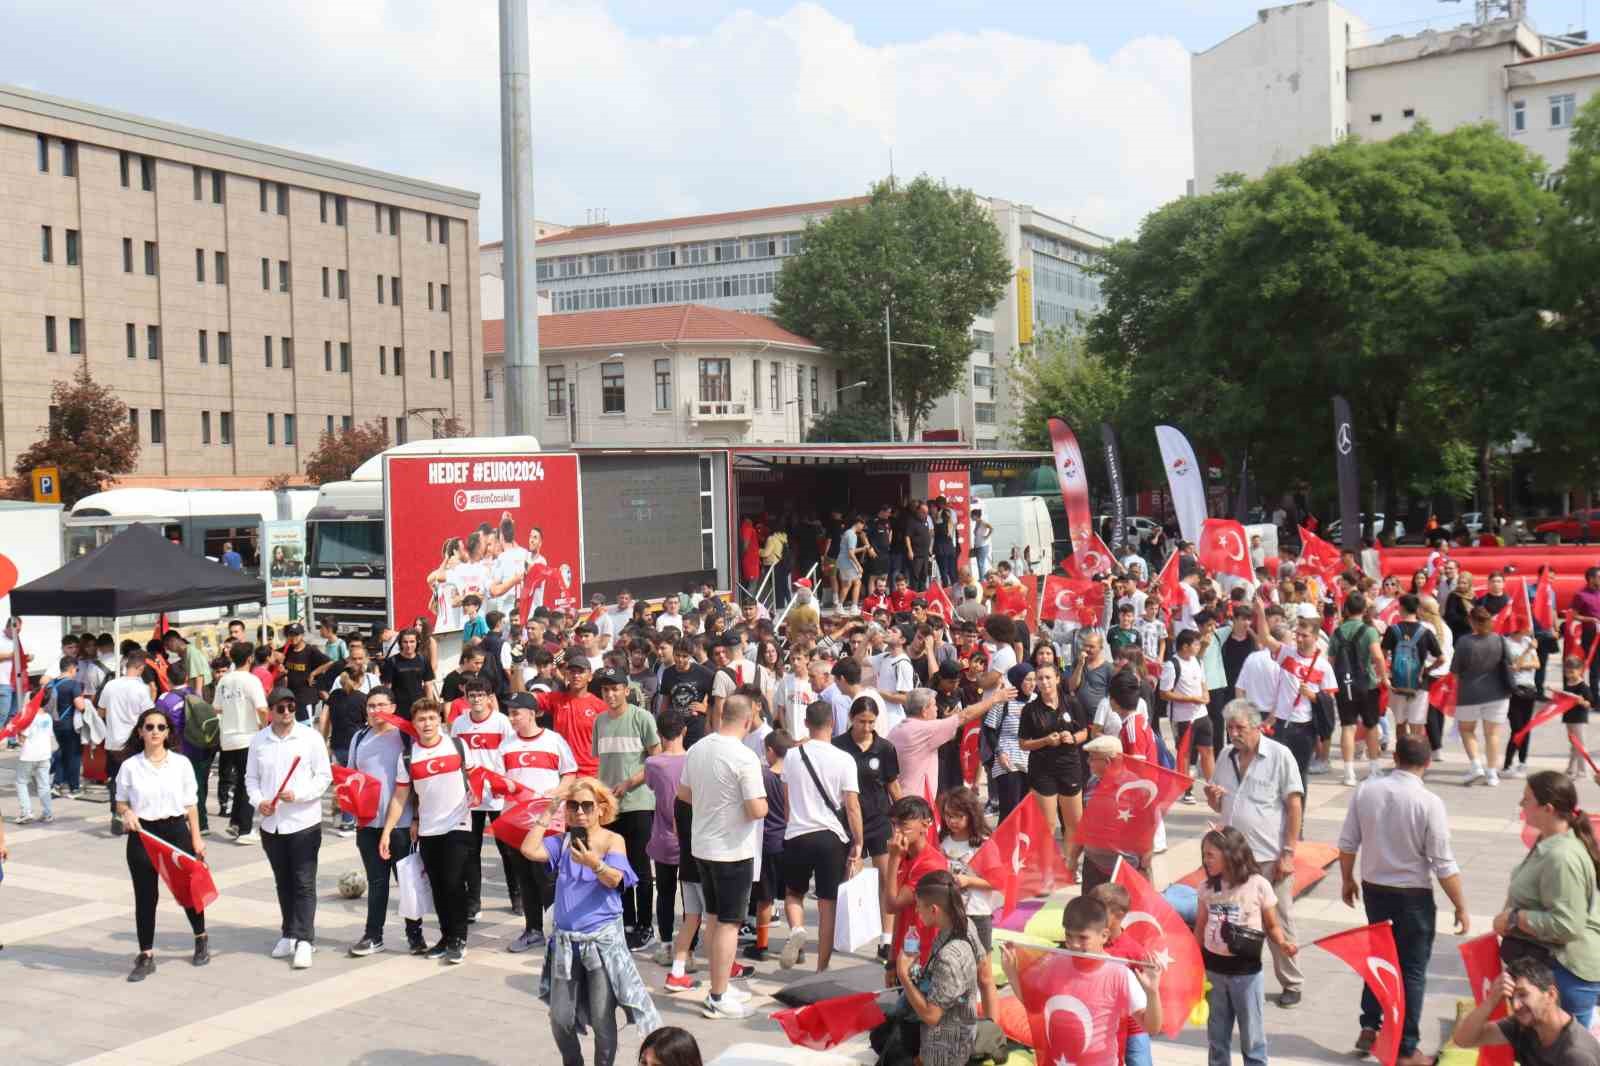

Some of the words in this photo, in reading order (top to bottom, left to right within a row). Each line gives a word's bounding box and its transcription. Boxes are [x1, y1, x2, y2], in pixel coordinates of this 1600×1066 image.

[428, 462, 470, 484] HEDEF
[473, 460, 545, 482] #EURO2024
[41, 477, 51, 493] P
